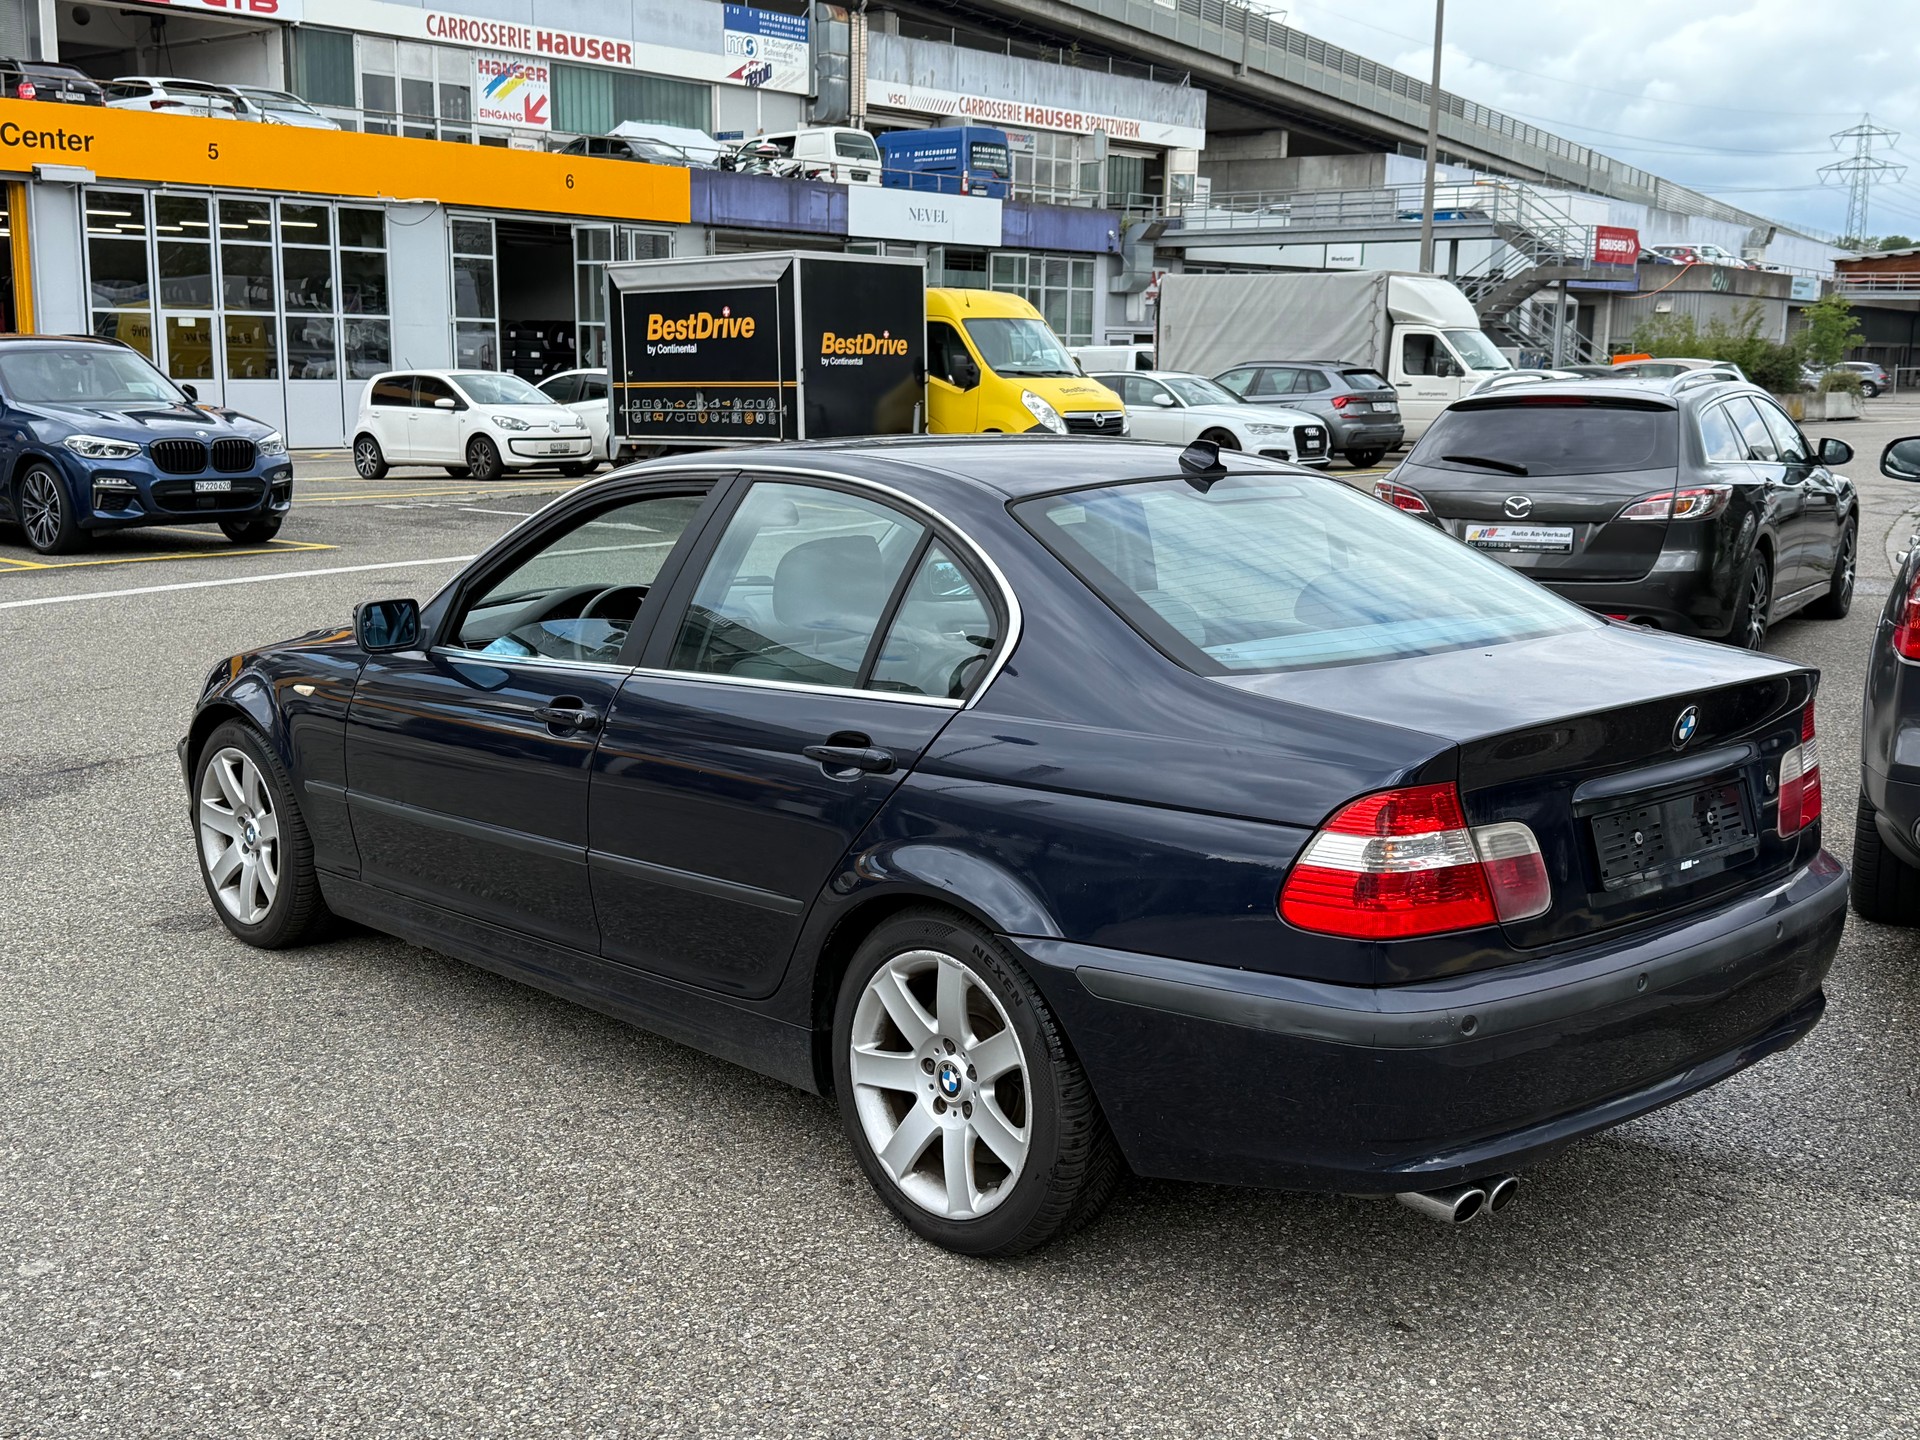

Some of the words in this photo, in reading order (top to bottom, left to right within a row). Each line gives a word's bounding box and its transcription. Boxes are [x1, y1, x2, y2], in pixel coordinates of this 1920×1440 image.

[426, 14, 531, 50] CARROSSERIE
[479, 108, 523, 122] EINGANG
[888, 92, 907, 105] VSCI
[958, 97, 1022, 121] CARROSSERIE
[1085, 114, 1141, 138] SPRITZWERK
[0, 121, 95, 153] Center
[207, 142, 219, 160] 5
[565, 174, 575, 189] 6
[909, 206, 949, 224] NEVEL
[647, 306, 755, 341] BestDrive
[647, 344, 656, 356] by
[657, 343, 697, 354] Continental
[821, 330, 908, 356] BestDrive
[821, 357, 829, 367] by
[830, 356, 863, 366] Continental
[972, 944, 1023, 1007] NEXEN
